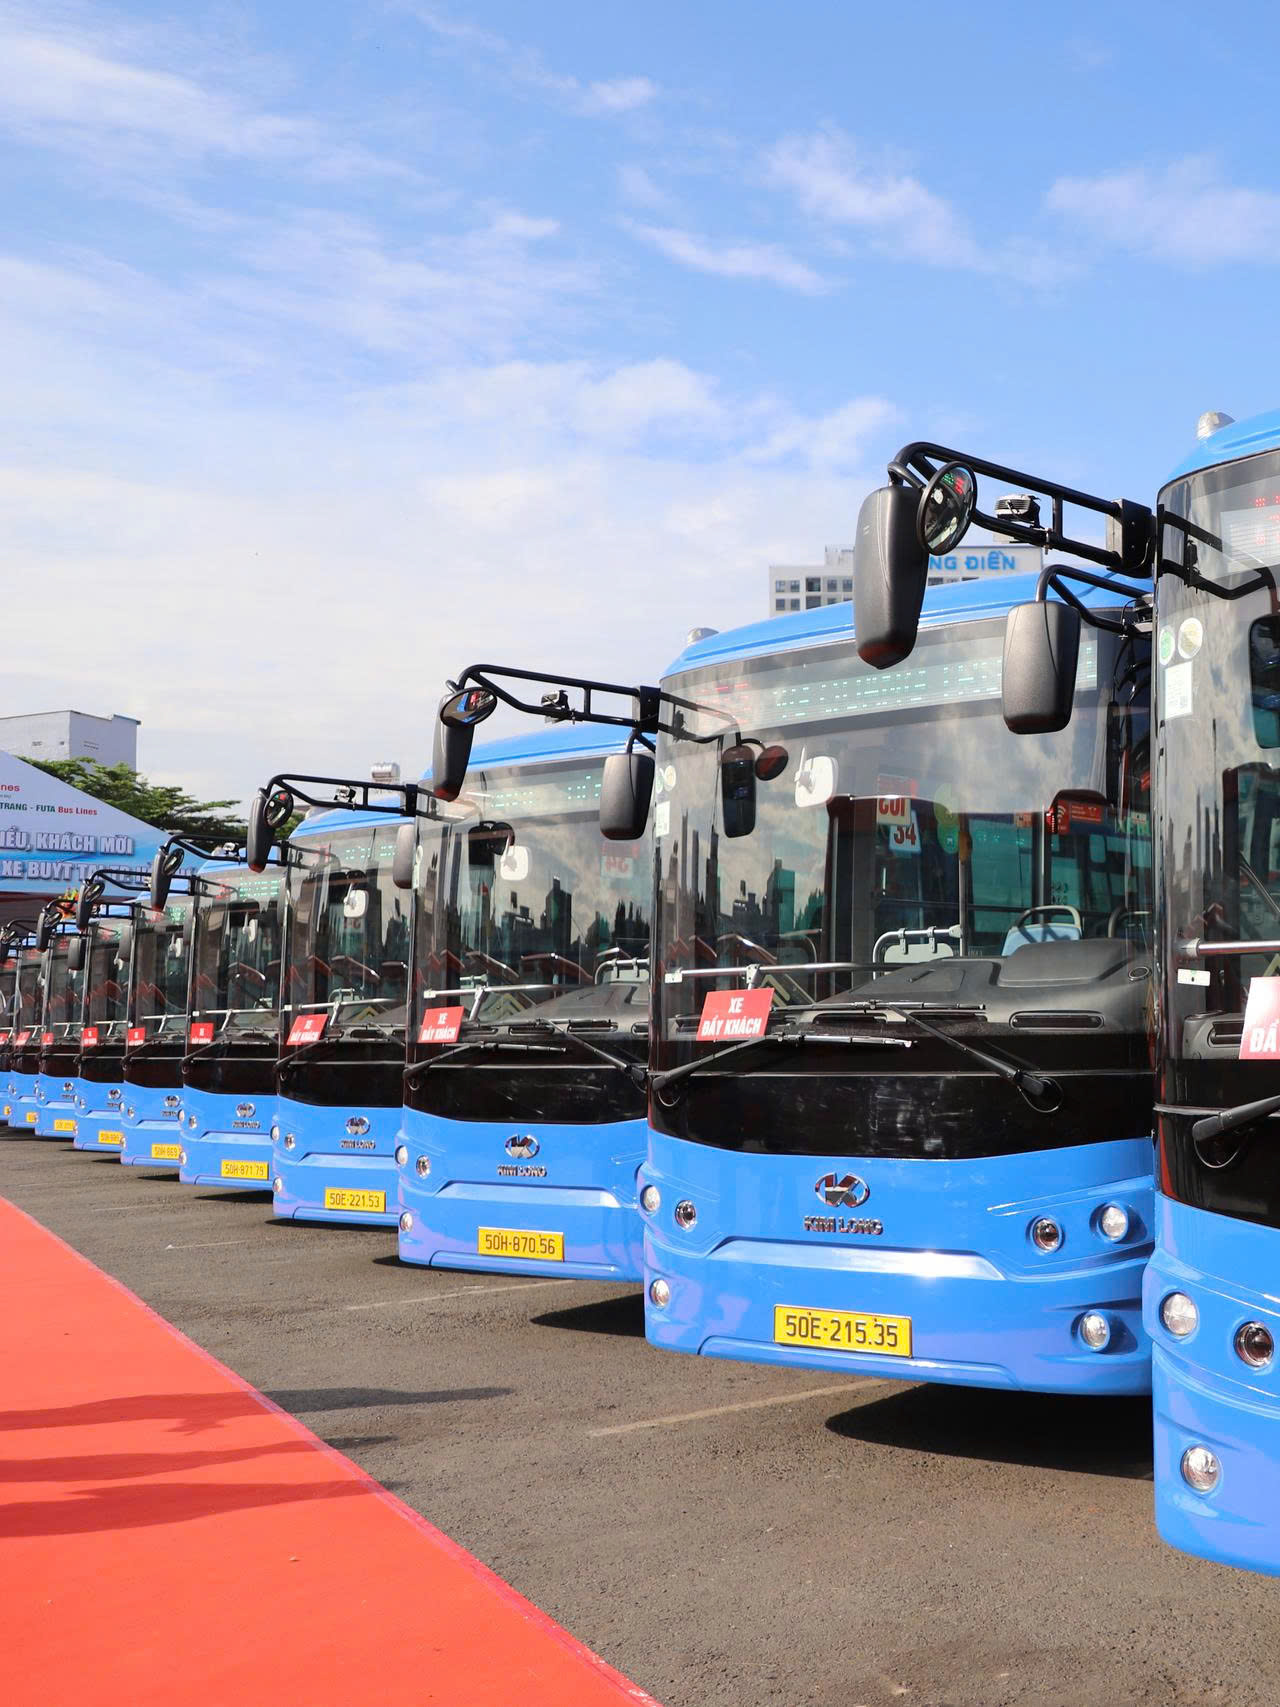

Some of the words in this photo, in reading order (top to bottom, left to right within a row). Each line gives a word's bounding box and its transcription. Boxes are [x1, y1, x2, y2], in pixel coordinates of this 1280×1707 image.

[929, 556, 957, 570] NG
[0, 802, 28, 811] TRANG
[36, 804, 55, 812] FUTA
[76, 807, 98, 815] Lines
[36, 831, 96, 851] KHÁCH
[101, 835, 133, 855] MỜI
[2, 860, 23, 877] XE
[28, 860, 72, 879] BUÝT
[728, 997, 744, 1013] XE
[724, 1016, 762, 1035] KHÁCH
[804, 1215, 836, 1232] KIM
[839, 1217, 884, 1235] LONG
[485, 1234, 556, 1254] 50H-870.56
[786, 1314, 898, 1348] 50E-215.35
